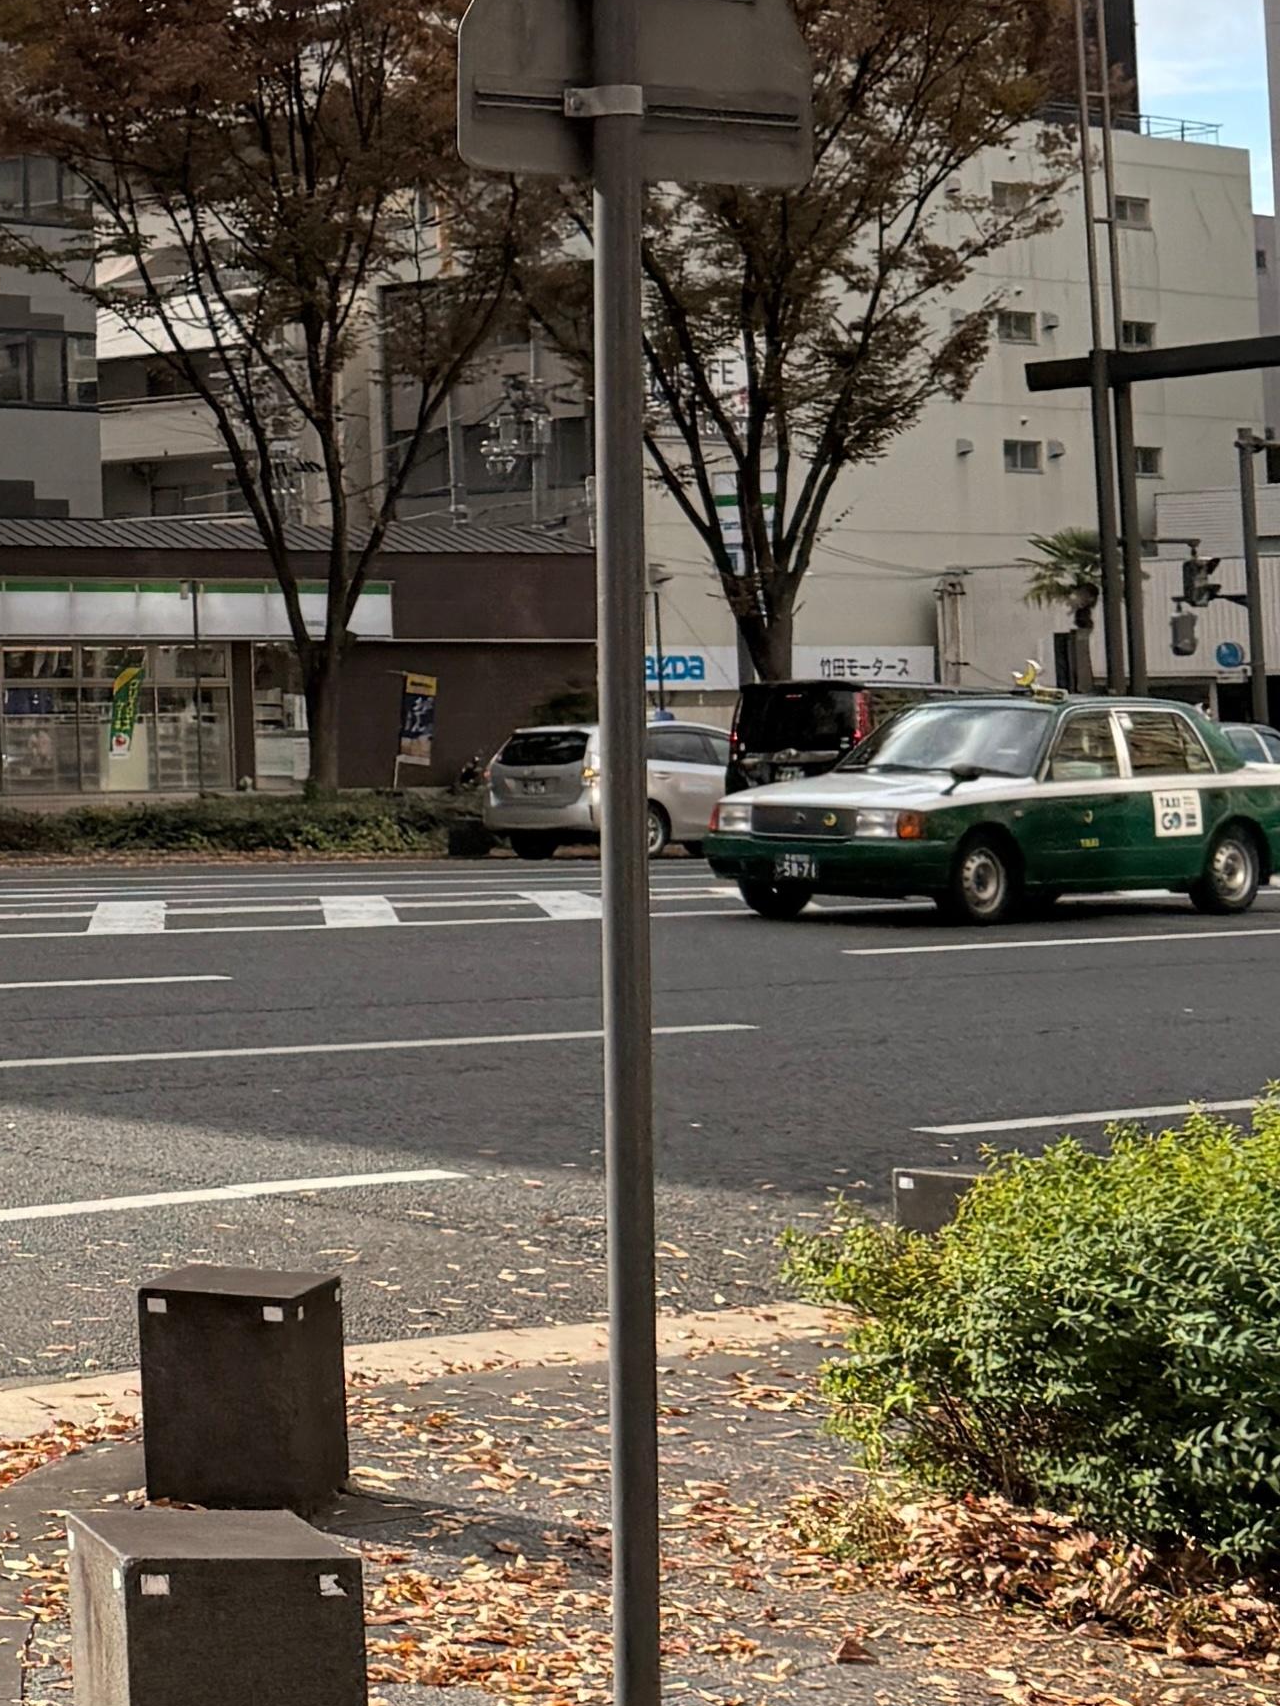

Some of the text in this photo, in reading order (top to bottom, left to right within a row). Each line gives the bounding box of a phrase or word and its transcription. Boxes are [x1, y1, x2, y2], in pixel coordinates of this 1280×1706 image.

[820, 657, 909, 678] 竹田モータース
